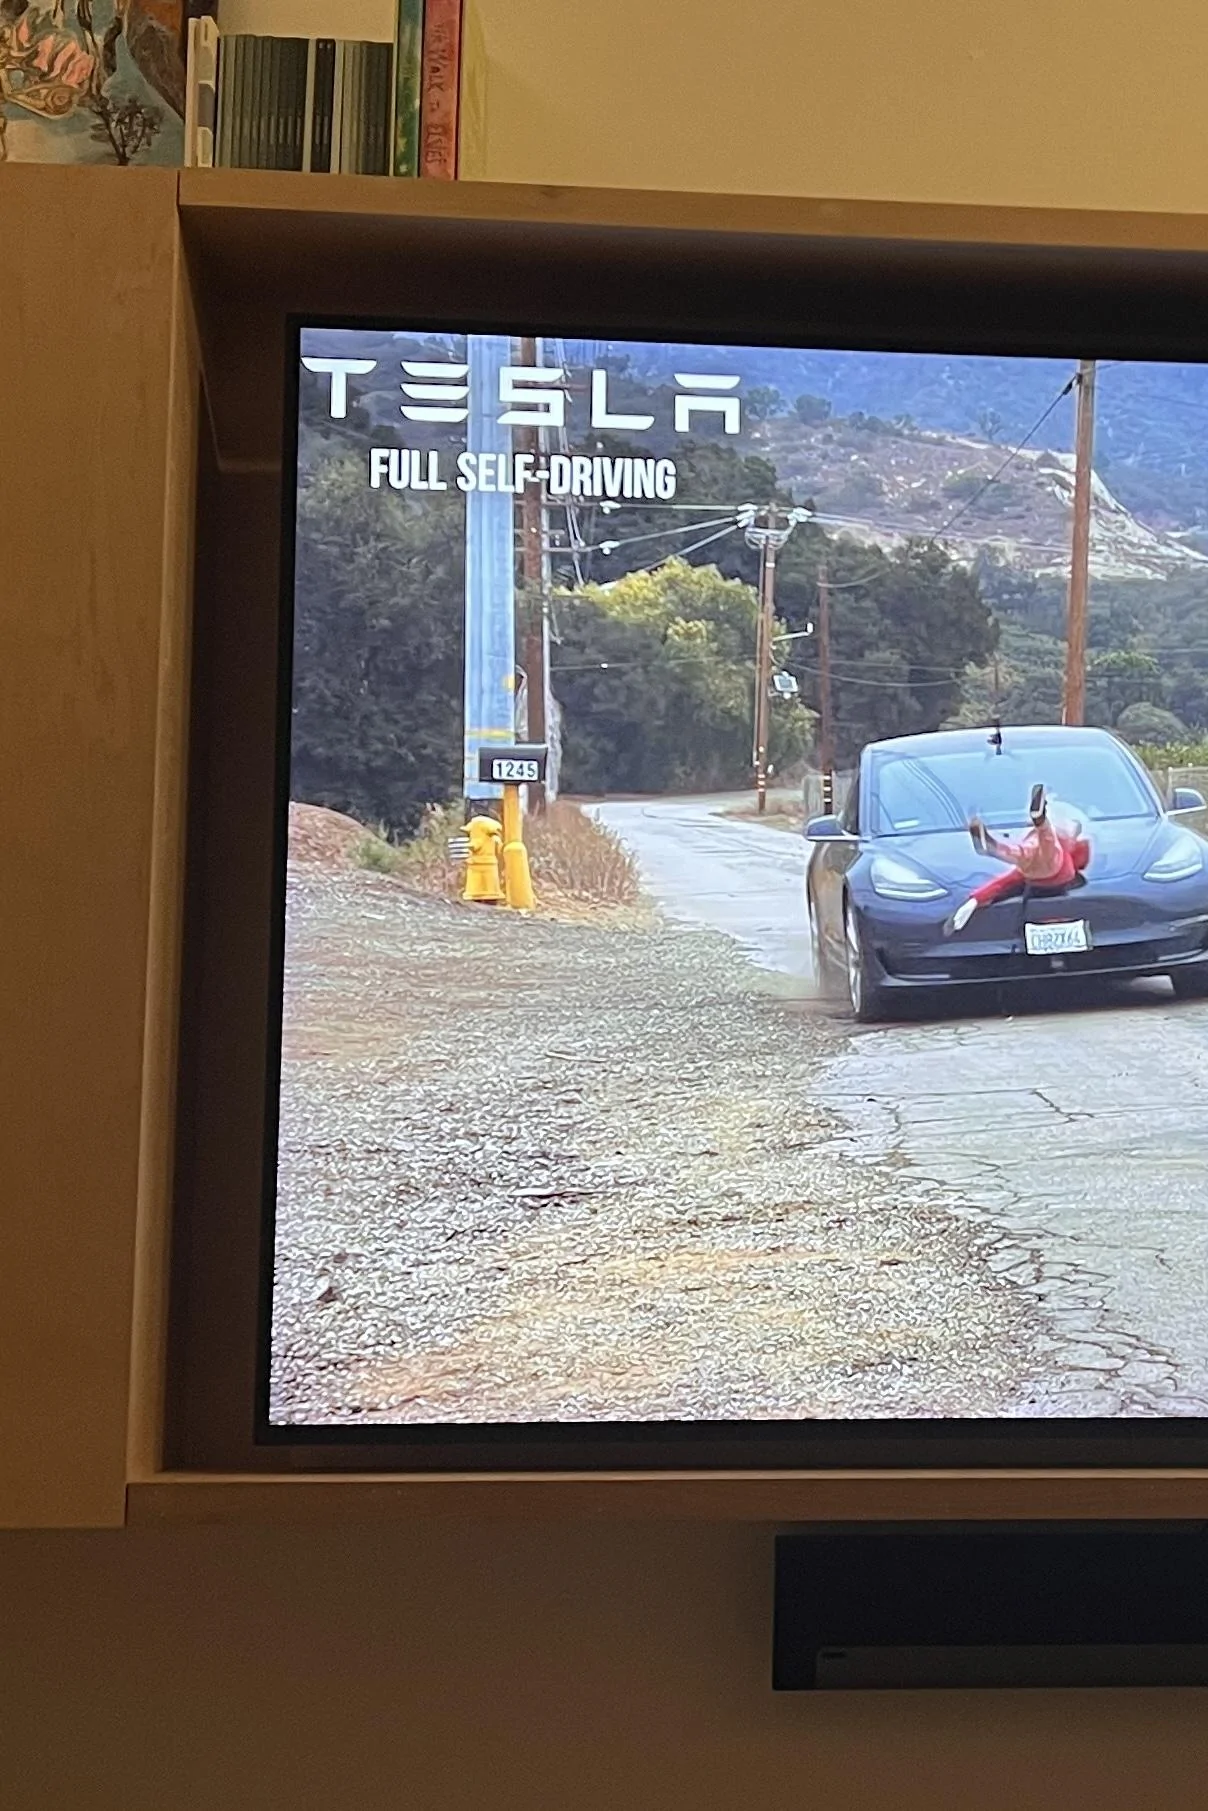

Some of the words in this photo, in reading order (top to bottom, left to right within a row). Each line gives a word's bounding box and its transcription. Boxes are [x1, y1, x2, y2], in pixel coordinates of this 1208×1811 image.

[301, 357, 742, 434] TESLA
[369, 447, 447, 491] FULL
[456, 450, 677, 500] SELF-DRIVING
[496, 761, 536, 778] 1245
